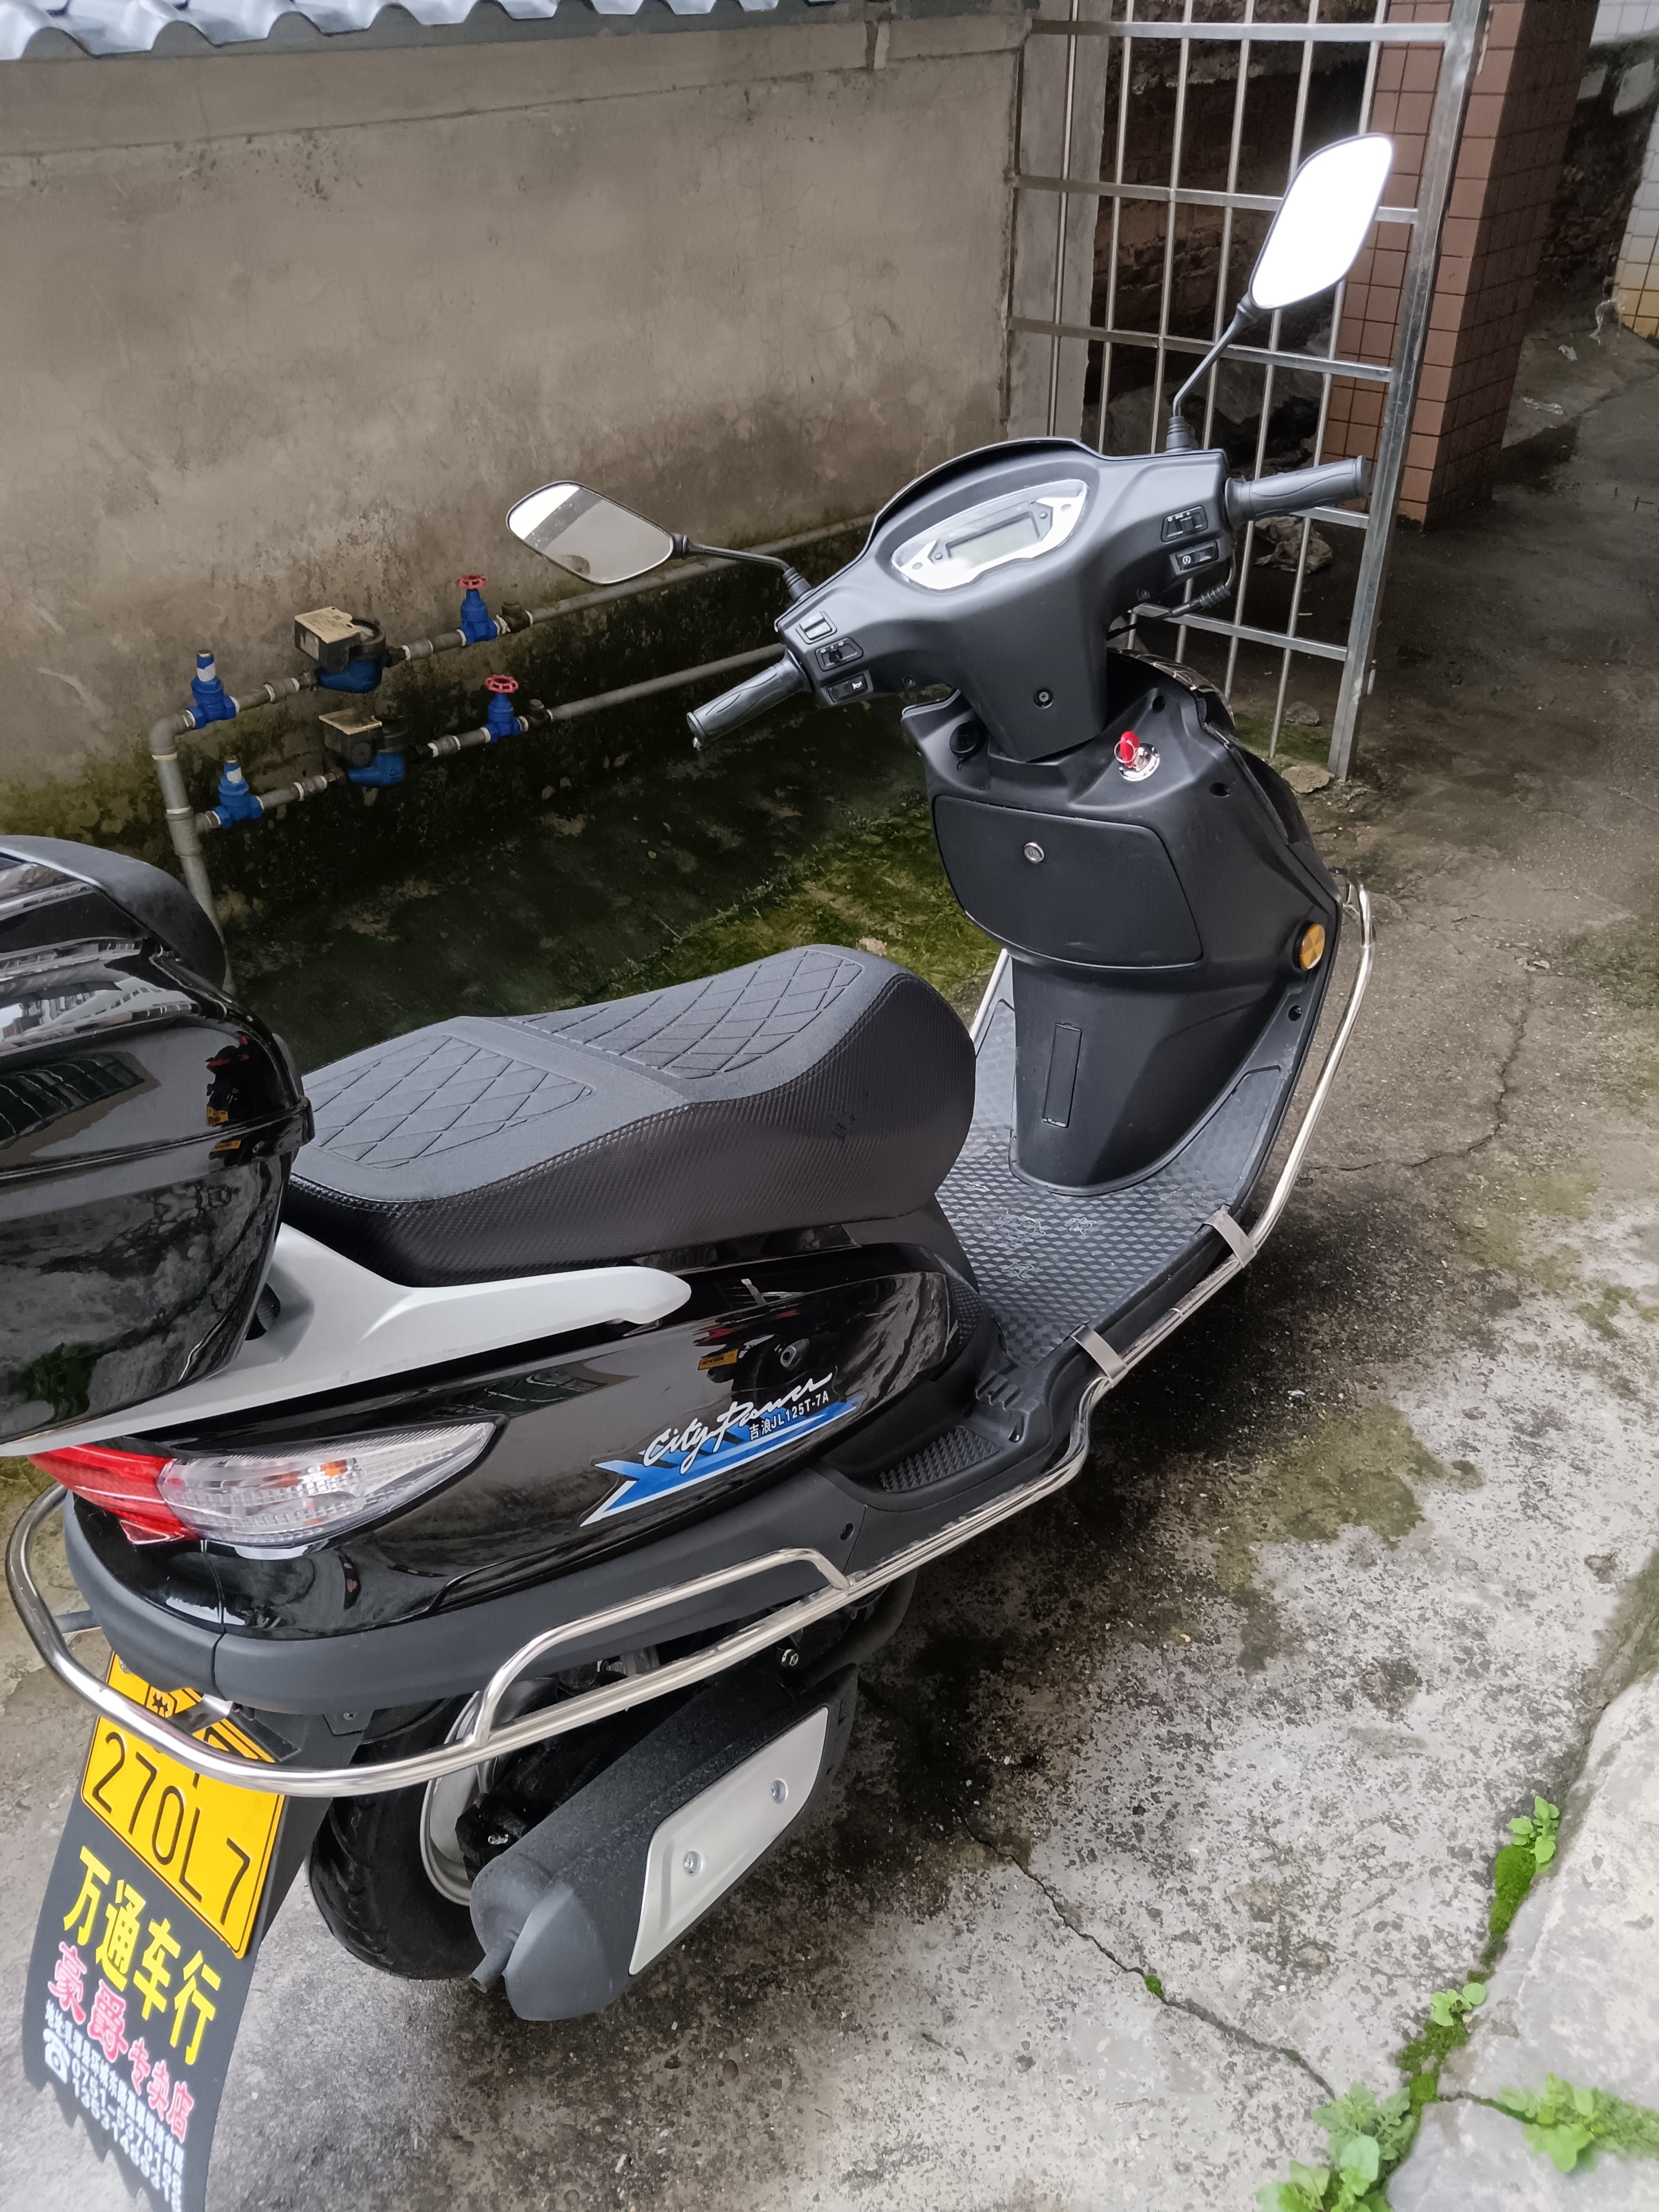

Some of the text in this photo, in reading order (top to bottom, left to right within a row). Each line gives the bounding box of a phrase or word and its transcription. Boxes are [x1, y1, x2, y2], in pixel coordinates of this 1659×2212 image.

[643, 1418, 717, 1475] City
[91, 1731, 252, 1926] 270L7
[63, 1845, 221, 2066] 万通车行
[71, 2058, 182, 2196] 0751-5370168
